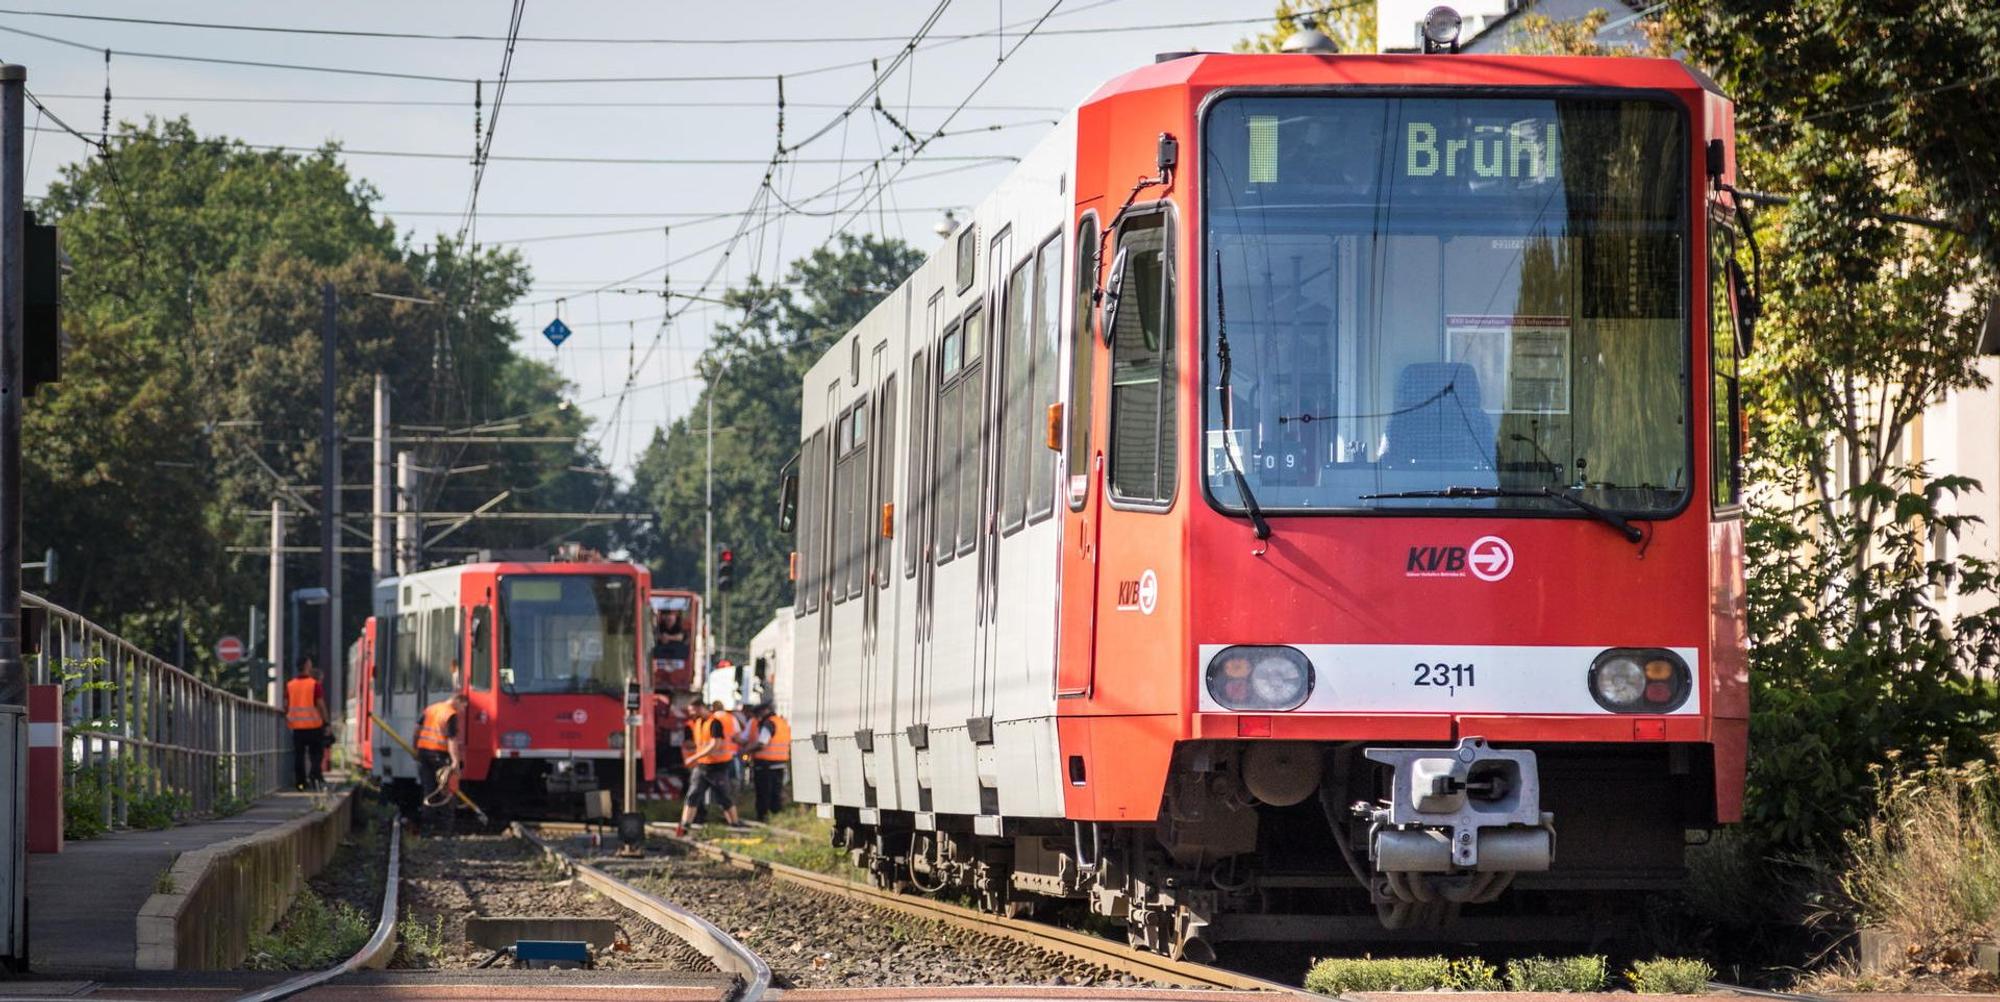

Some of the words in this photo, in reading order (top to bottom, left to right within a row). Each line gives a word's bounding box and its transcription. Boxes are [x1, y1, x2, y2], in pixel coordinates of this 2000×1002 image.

[1407, 121, 1557, 179] Brühl
[1406, 547, 1467, 571] KVB
[1118, 580, 1140, 605] KVB
[1414, 662, 1475, 687] 2311
